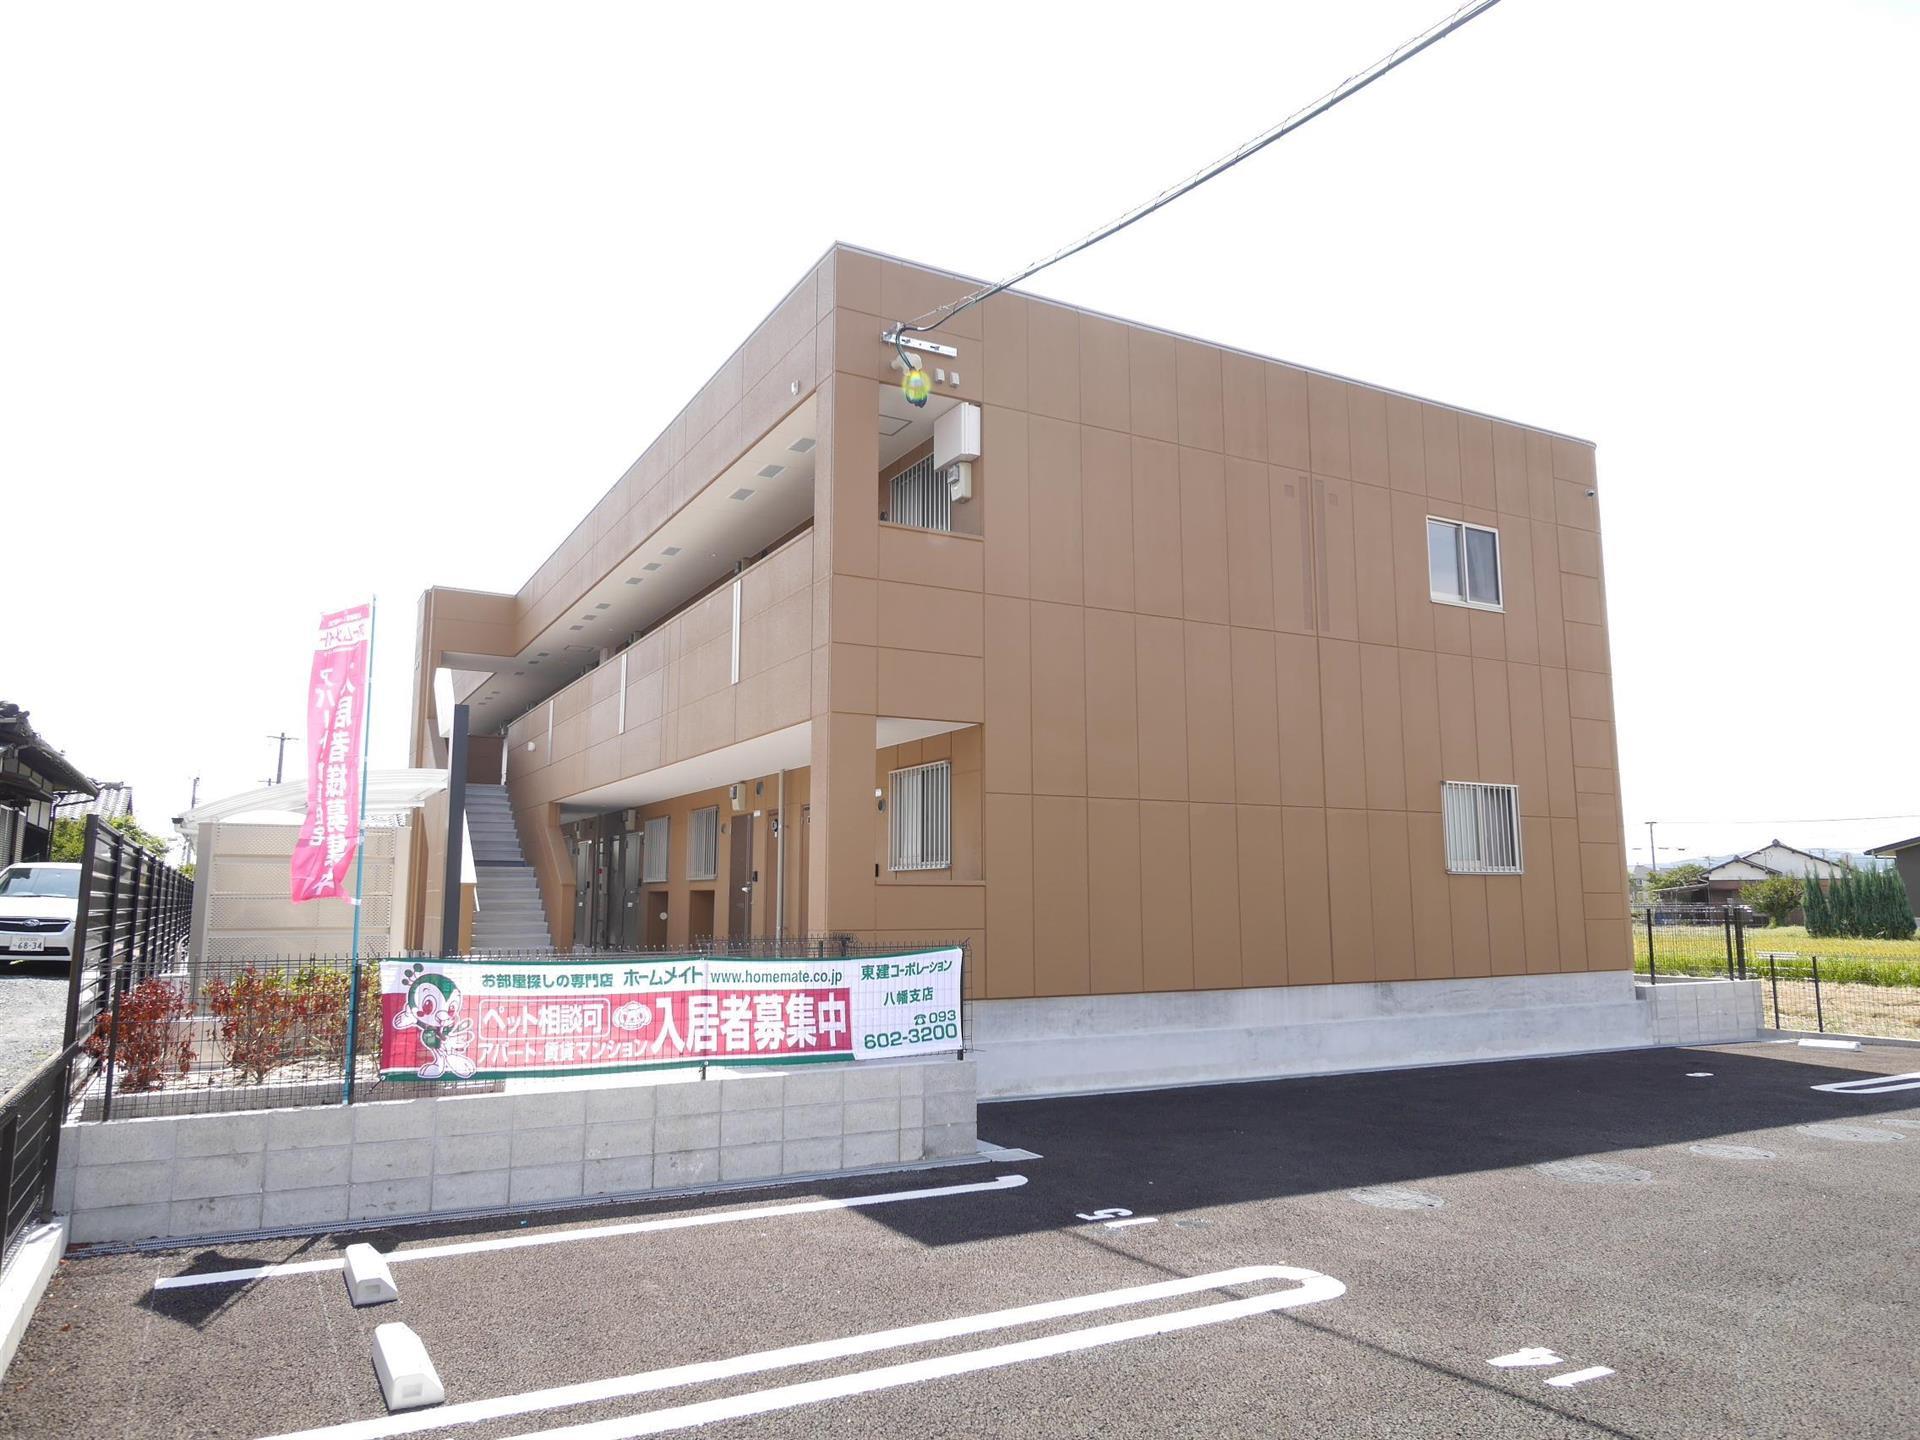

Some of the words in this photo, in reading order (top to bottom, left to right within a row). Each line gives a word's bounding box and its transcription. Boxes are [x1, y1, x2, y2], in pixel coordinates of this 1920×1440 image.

[482, 973, 614, 990] お部屋探しの専門店
[623, 966, 704, 987] ホームメイト
[710, 969, 843, 986] www.homemate.co.jp
[861, 959, 953, 981] 東建コーポレーション
[883, 986, 934, 1007] 八幡支店
[482, 1003, 605, 1036] ペット相談可
[651, 991, 847, 1054] 入居者募集中
[928, 1009, 957, 1024] 093
[864, 1022, 958, 1050] 602-3200
